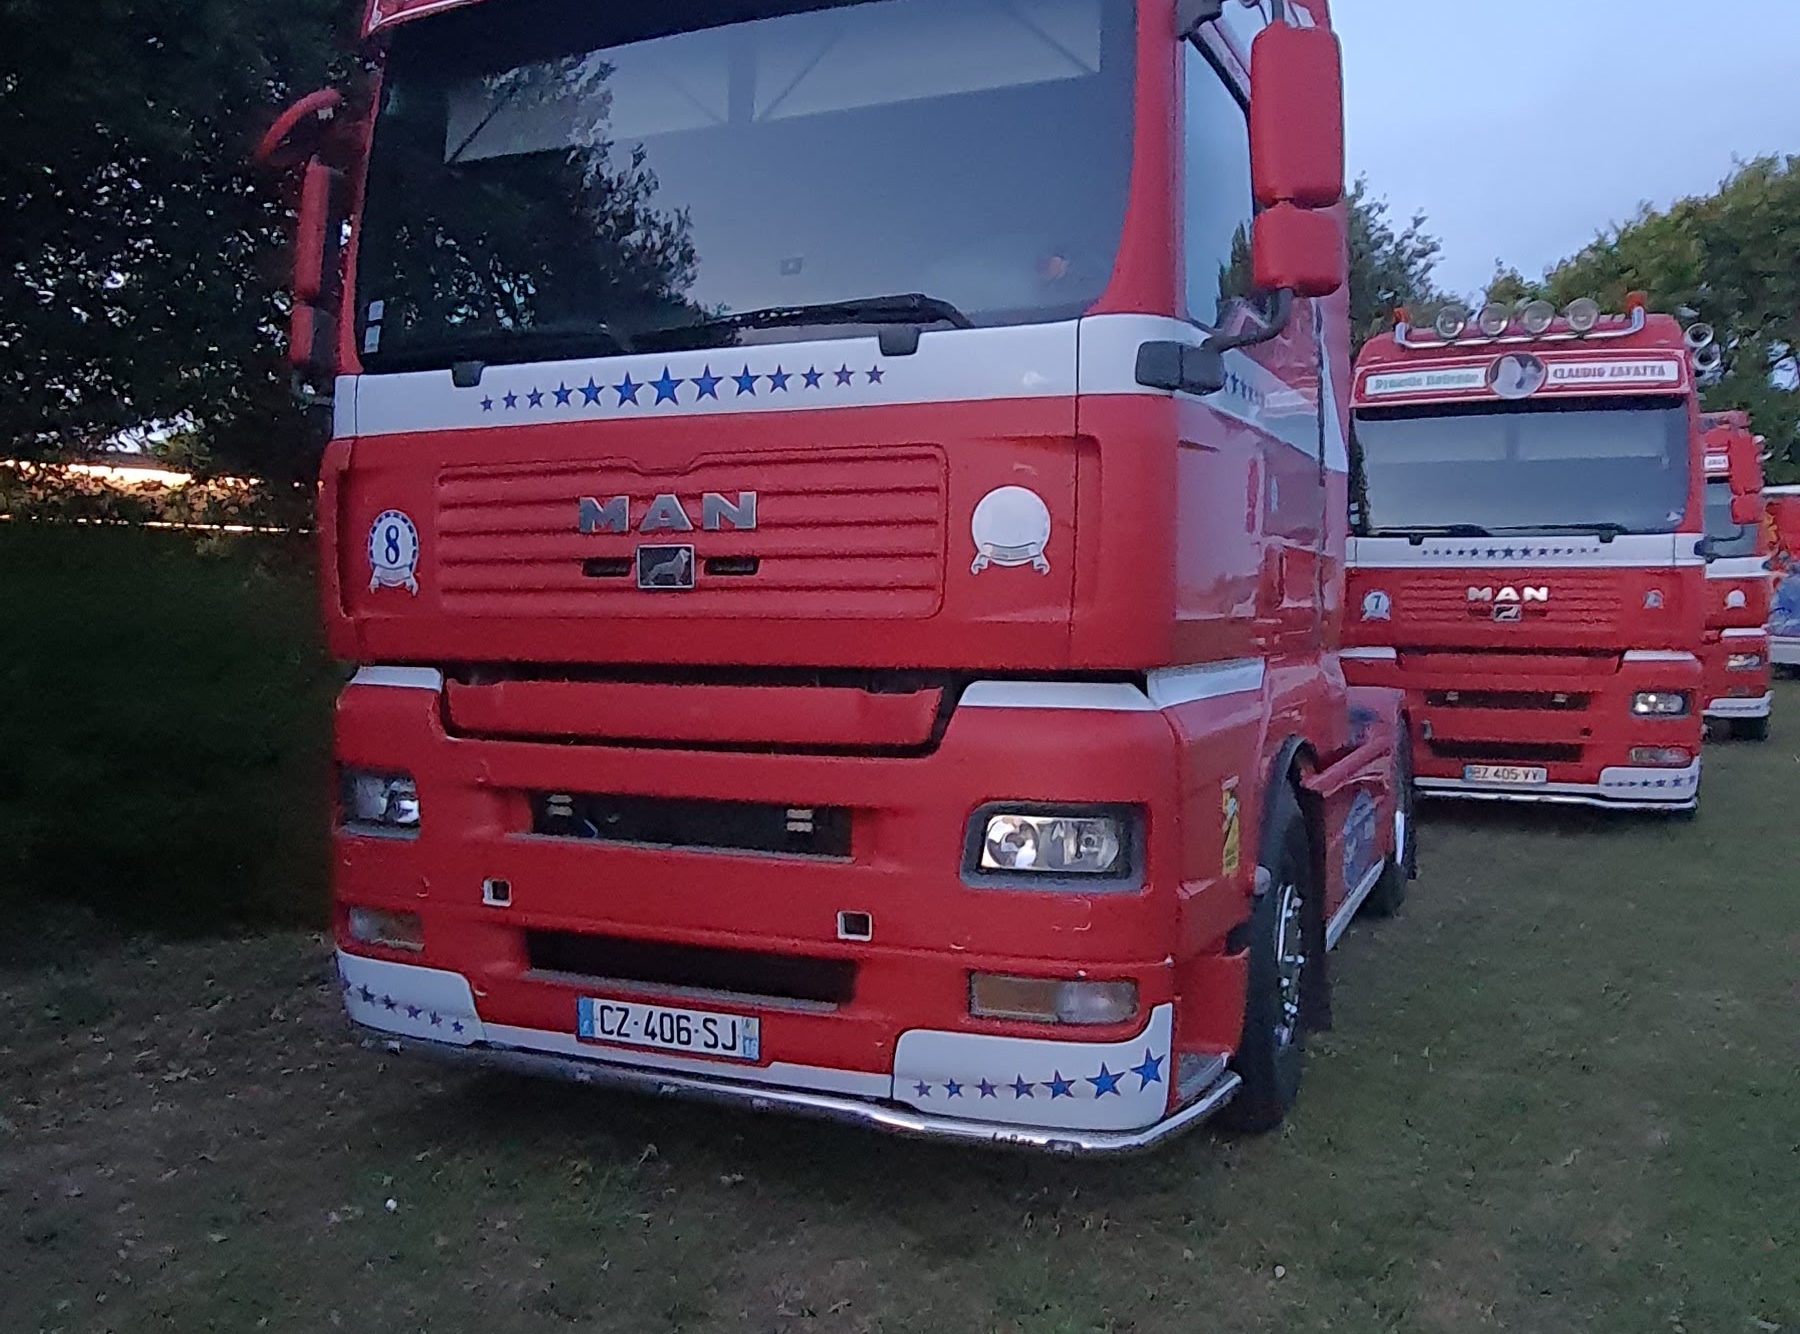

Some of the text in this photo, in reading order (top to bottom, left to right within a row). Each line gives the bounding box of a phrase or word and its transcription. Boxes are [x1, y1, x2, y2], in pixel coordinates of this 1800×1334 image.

[578, 491, 757, 535] MAN
[385, 524, 400, 565] 8
[1372, 594, 1382, 610] 7
[1467, 585, 1549, 602] MAN
